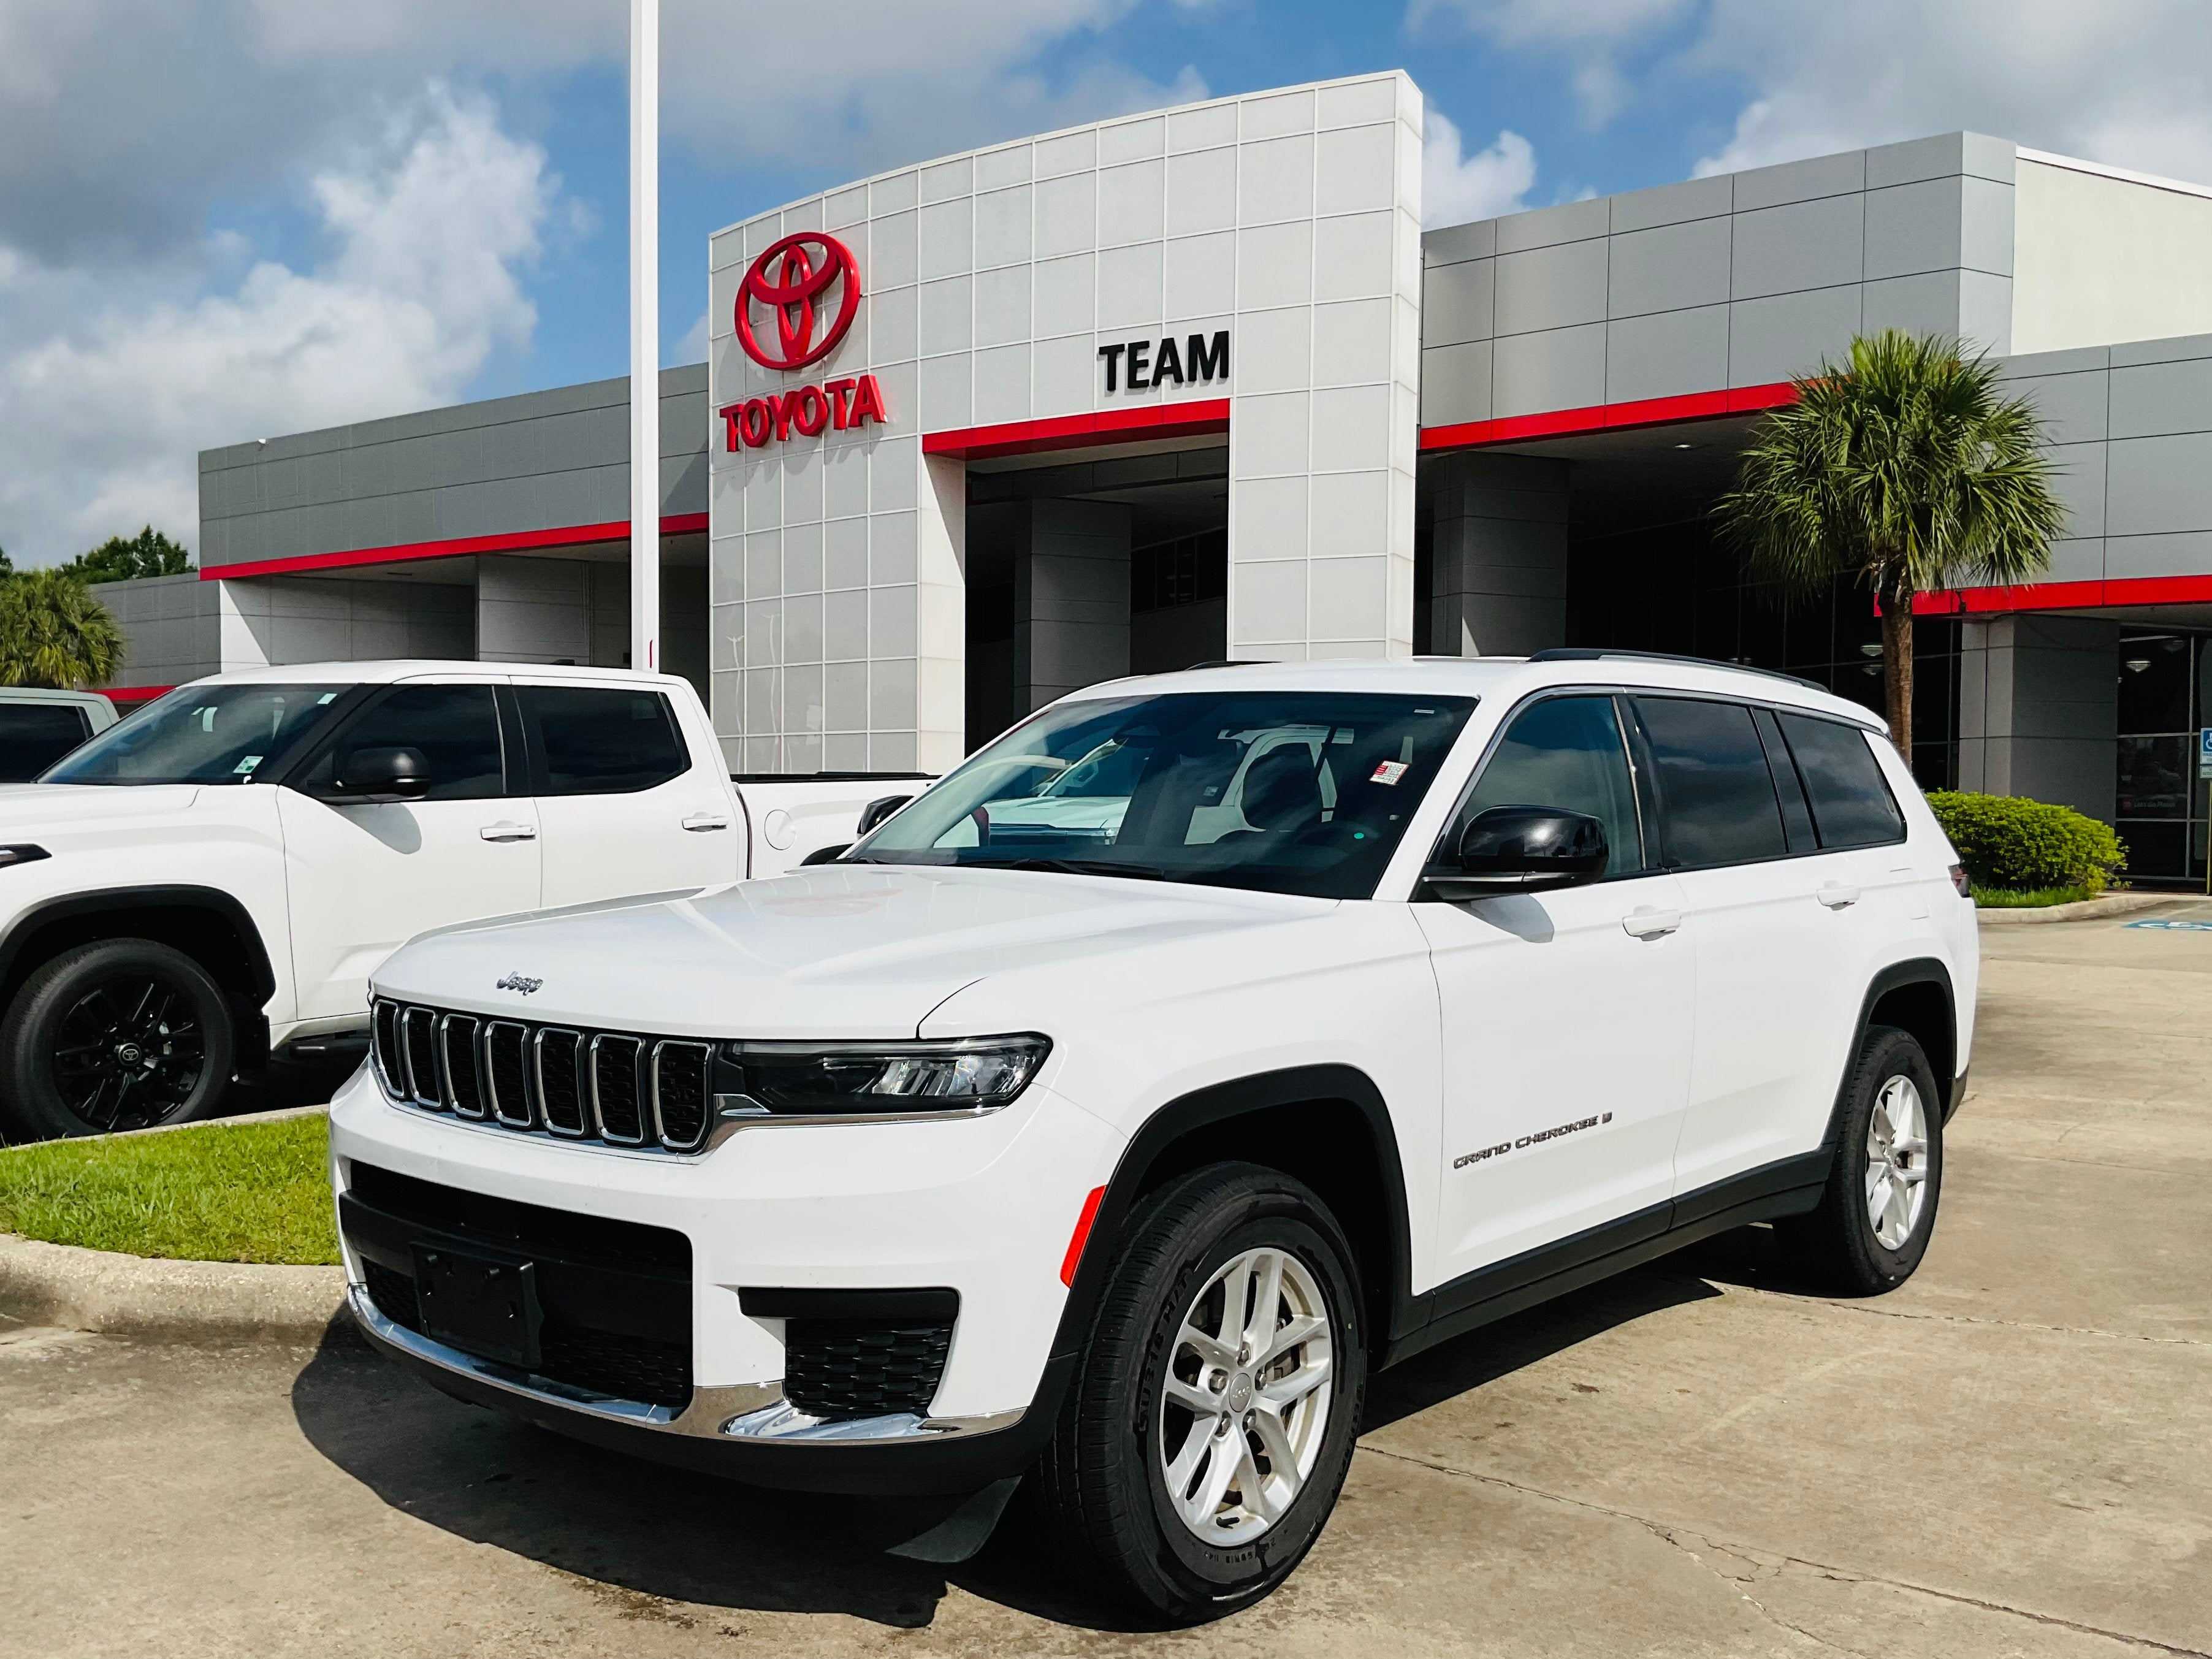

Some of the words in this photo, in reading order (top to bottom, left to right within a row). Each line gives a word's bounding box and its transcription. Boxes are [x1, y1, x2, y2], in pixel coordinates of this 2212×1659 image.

[1099, 330, 1230, 391] TEAM
[719, 374, 888, 452] TOYOTA
[496, 971, 543, 996] Jeep
[1453, 1142, 1511, 1169] GRAND
[1515, 1115, 1598, 1149] CHEROKEE
